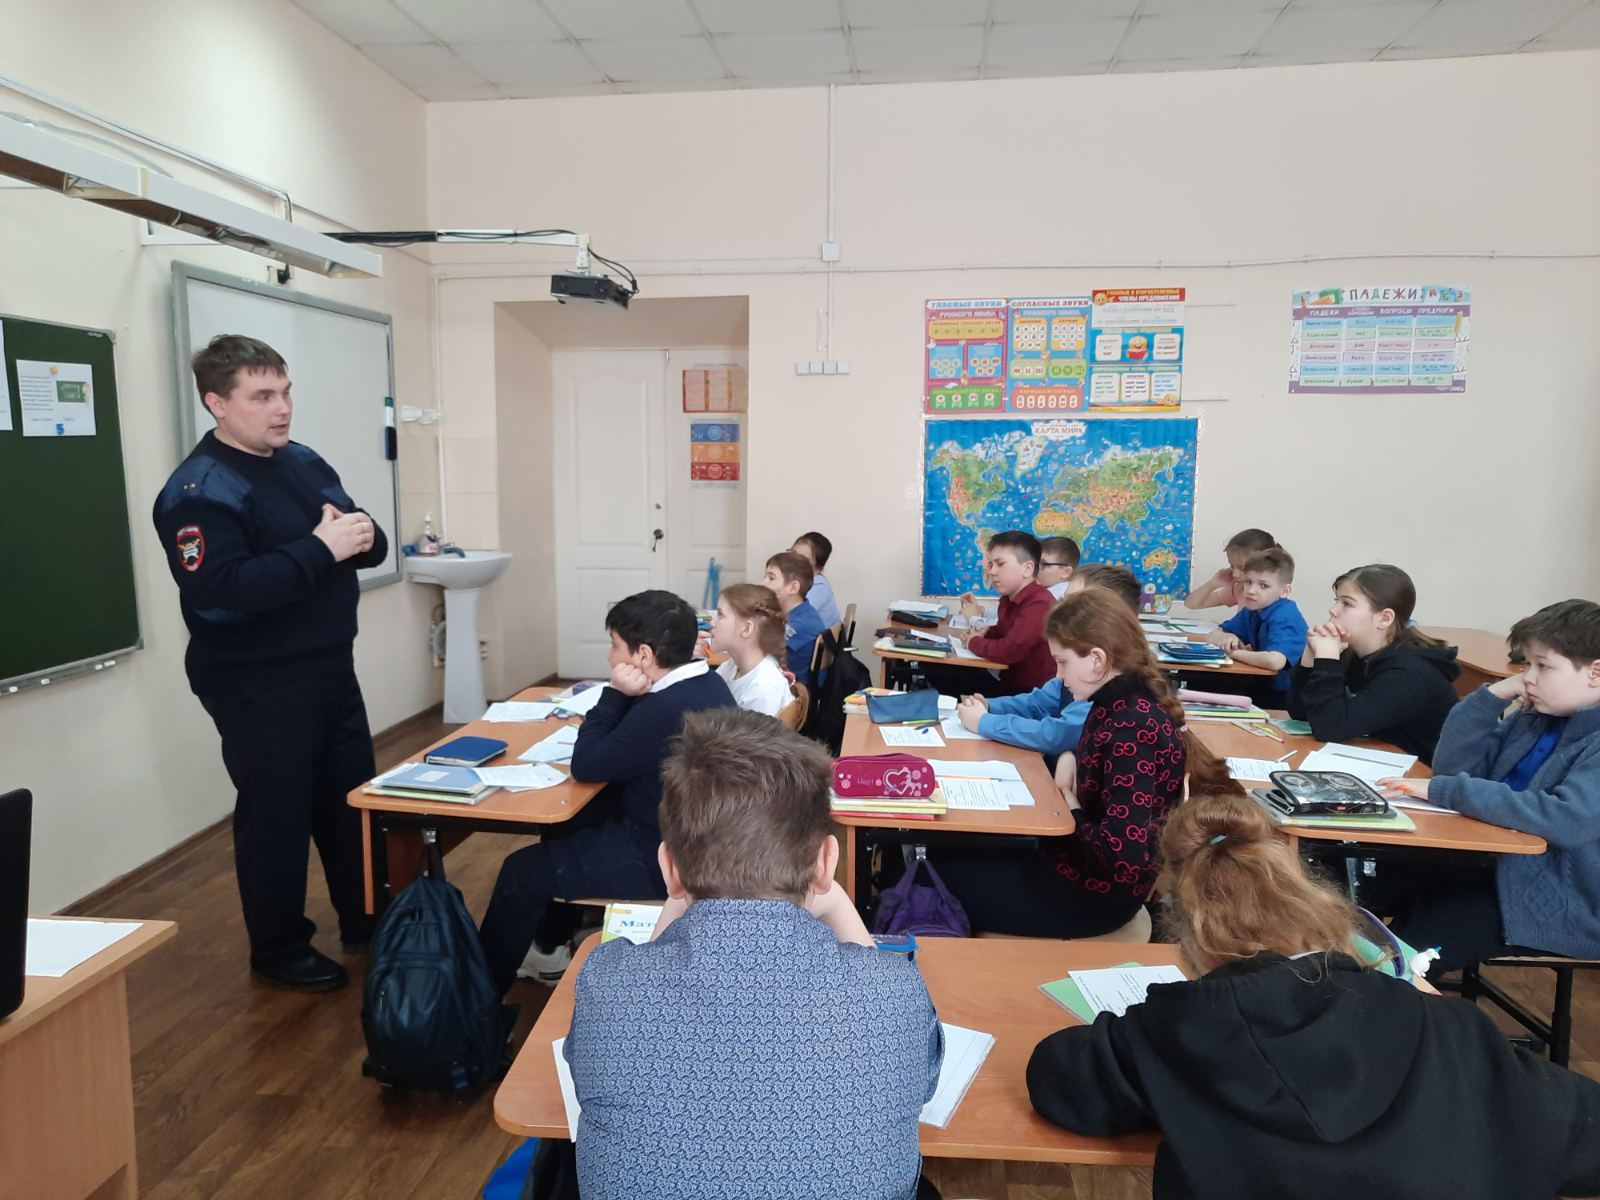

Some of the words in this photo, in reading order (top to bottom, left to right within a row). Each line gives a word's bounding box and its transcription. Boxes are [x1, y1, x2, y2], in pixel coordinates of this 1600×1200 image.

[1349, 287, 1417, 300] ПАДЕЖИ
[931, 301, 972, 309] ГЛАСНЫЕ
[974, 300, 1002, 308] ЗВУКИ
